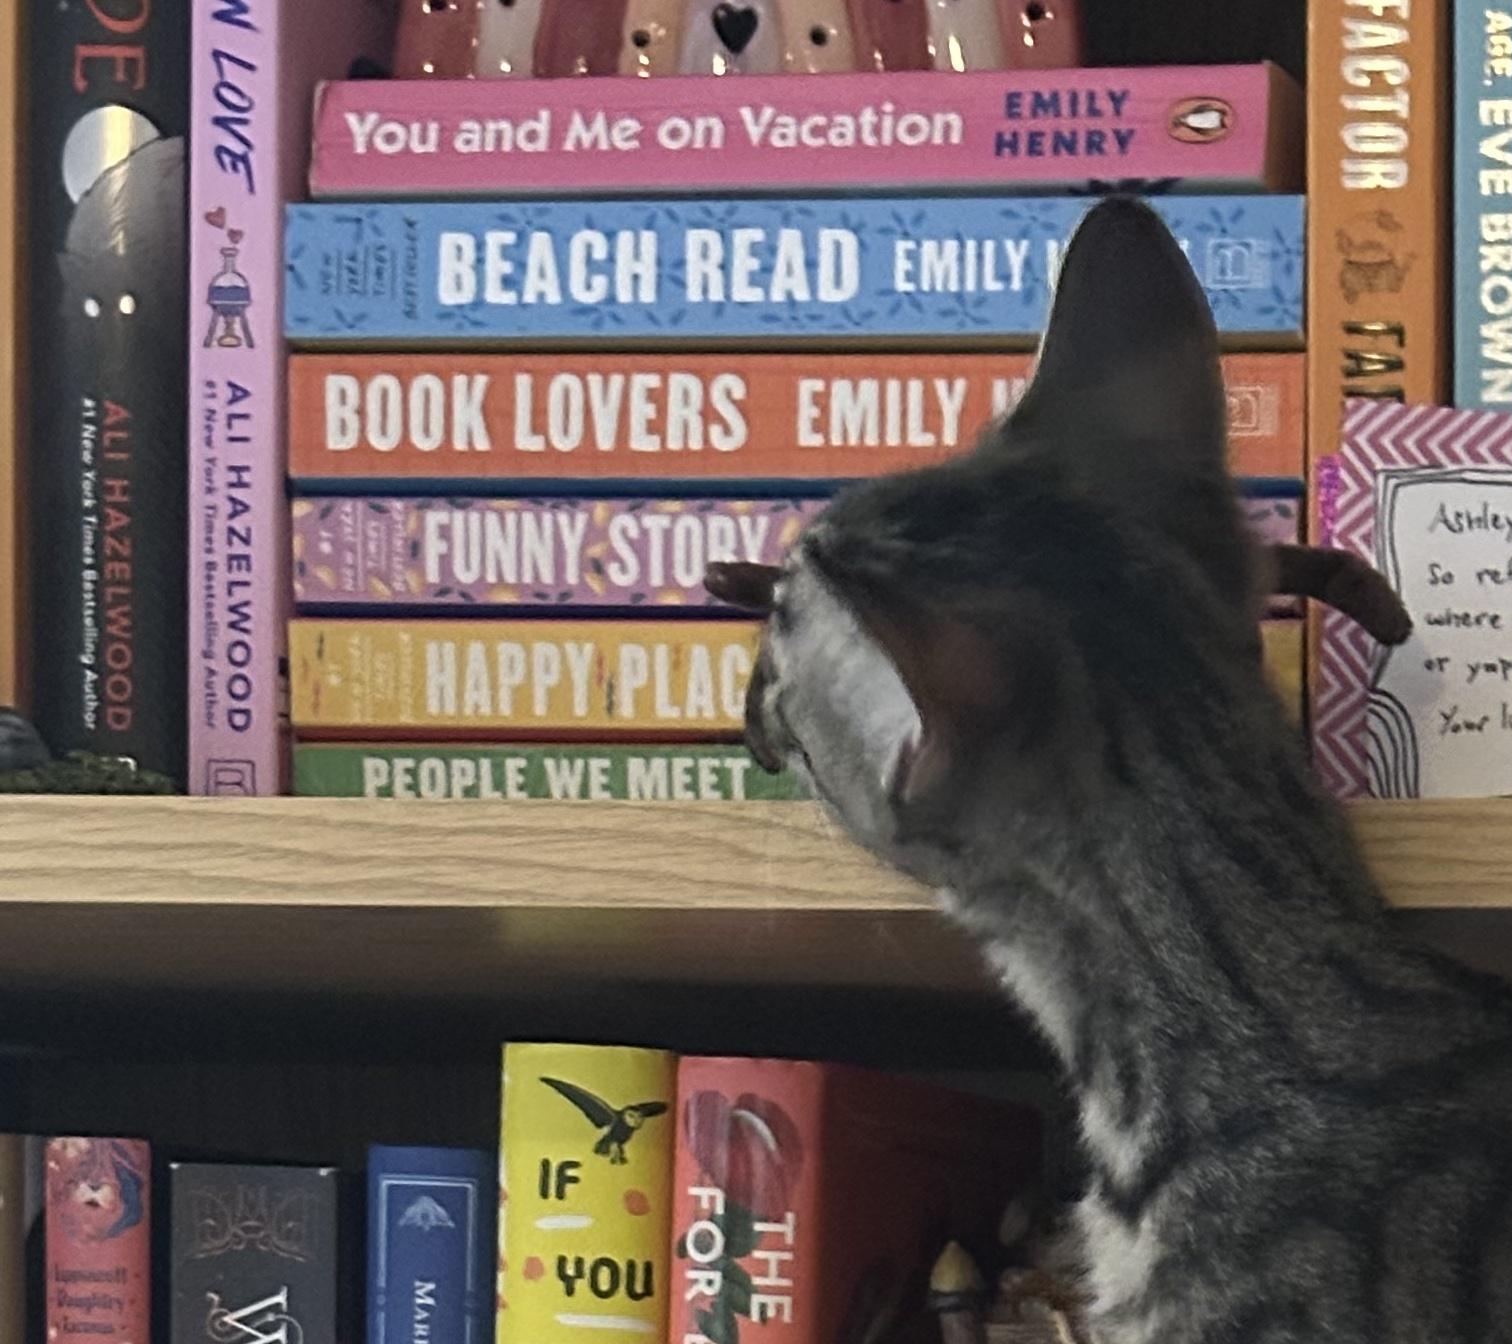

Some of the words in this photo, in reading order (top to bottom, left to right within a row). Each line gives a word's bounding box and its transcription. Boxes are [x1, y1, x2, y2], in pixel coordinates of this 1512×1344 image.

[210, 50, 256, 194] LOVE
[344, 111, 440, 154] You
[453, 109, 551, 153] and
[562, 110, 640, 151] Me
[656, 113, 725, 150] on
[739, 102, 964, 148] Vacation
[1004, 89, 1132, 121] EMILY
[993, 128, 1137, 158] HENRY
[437, 230, 659, 305] BEACH
[685, 227, 860, 303] READ
[893, 238, 1032, 293] EMILY
[103, 400, 132, 460] ALI
[226, 380, 252, 443] ALI
[324, 373, 492, 452] BOOK
[513, 373, 750, 452] LOVERS
[797, 377, 967, 447] EMILY
[80, 422, 96, 465] New
[80, 466, 98, 507] York
[80, 517, 98, 566] Times
[424, 509, 591, 586] FUNNY
[607, 513, 771, 588] STORY
[226, 465, 253, 733] HAZELWOOD
[1426, 563, 1455, 587] So
[79, 568, 100, 664] Bestselling
[103, 480, 133, 731] HAZELWOOD
[1423, 604, 1502, 629] where
[1423, 656, 1452, 673] or
[81, 669, 100, 729] Author
[1440, 706, 1491, 735] Your
[361, 757, 529, 800] PEOPLE
[543, 757, 611, 800] WE
[627, 757, 752, 800] MEET
[538, 1158, 584, 1201] IF
[684, 1185, 727, 1302] FOR
[750, 1211, 797, 1324] THE
[556, 1255, 654, 1301] YOU
